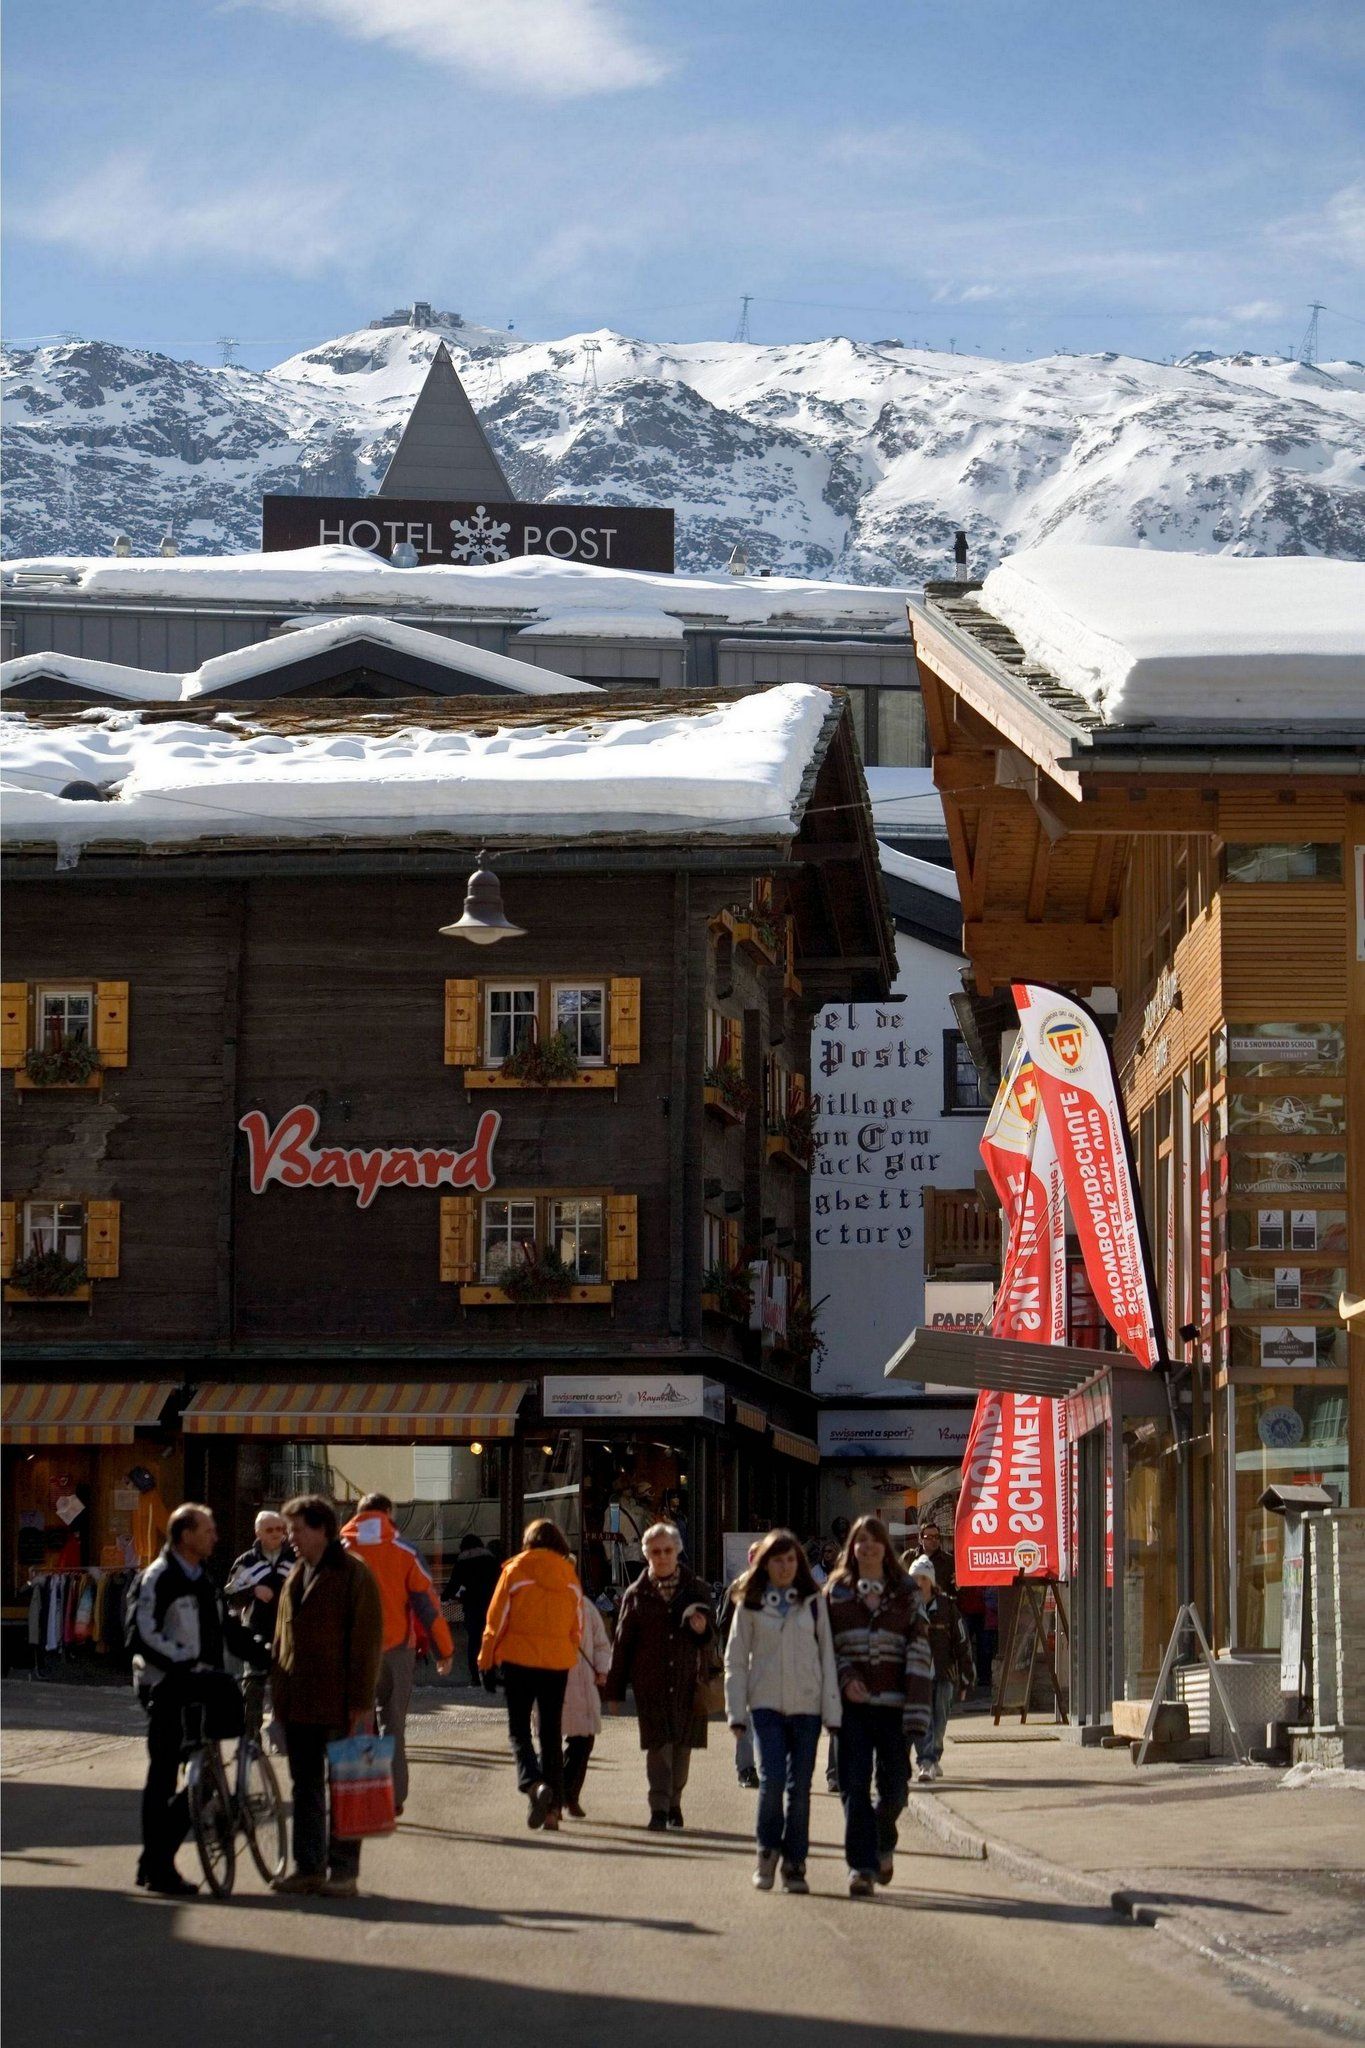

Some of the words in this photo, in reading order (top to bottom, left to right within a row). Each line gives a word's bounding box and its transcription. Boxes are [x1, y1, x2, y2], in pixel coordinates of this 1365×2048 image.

[319, 518, 442, 555] HOTEL
[523, 525, 618, 560] POST
[875, 1008, 904, 1030] de
[820, 1039, 933, 1077] Poste
[1233, 1041, 1243, 1049] SKI
[1244, 1041, 1249, 1049] &
[1250, 1041, 1290, 1049] SNOWBOARD
[1291, 1041, 1315, 1049] SCHOOL
[857, 1123, 931, 1153] Cow
[239, 1104, 502, 1209] Bayard
[884, 1152, 941, 1181] Bar
[816, 1223, 912, 1249] ctory
[932, 1312, 985, 1326] PAPER
